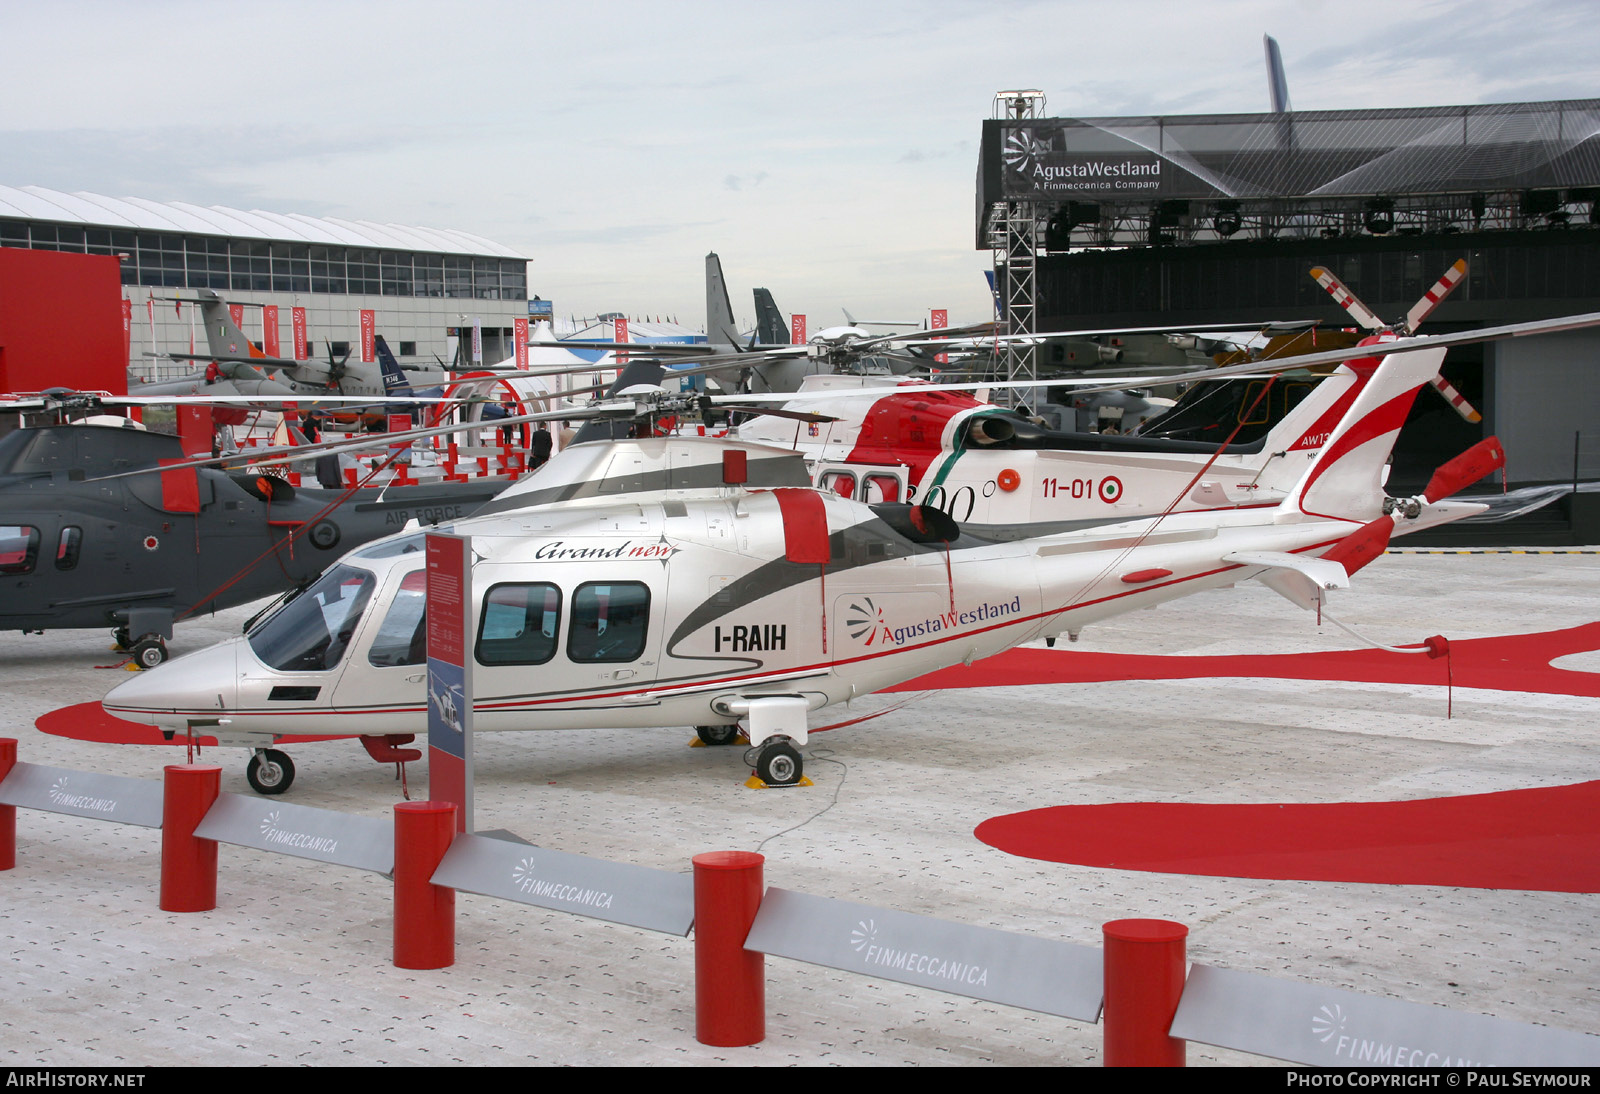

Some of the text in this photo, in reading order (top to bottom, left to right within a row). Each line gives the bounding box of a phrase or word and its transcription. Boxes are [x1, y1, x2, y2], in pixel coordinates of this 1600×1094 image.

[1033, 160, 1161, 181] AgustaWestland
[1033, 180, 1160, 190] A Finmeccanica Company
[1042, 477, 1093, 499] 11-01
[385, 504, 464, 525] AIR FORCE
[535, 540, 679, 560] Grand new
[882, 595, 1022, 645] AgustaWestland
[714, 624, 787, 653] I-RAIH
[53, 792, 118, 813] FINMECCANICA
[265, 829, 338, 854] FINMECCANICA
[520, 877, 615, 909] FINMECCANICA
[864, 944, 989, 987] FINMECCANICA
